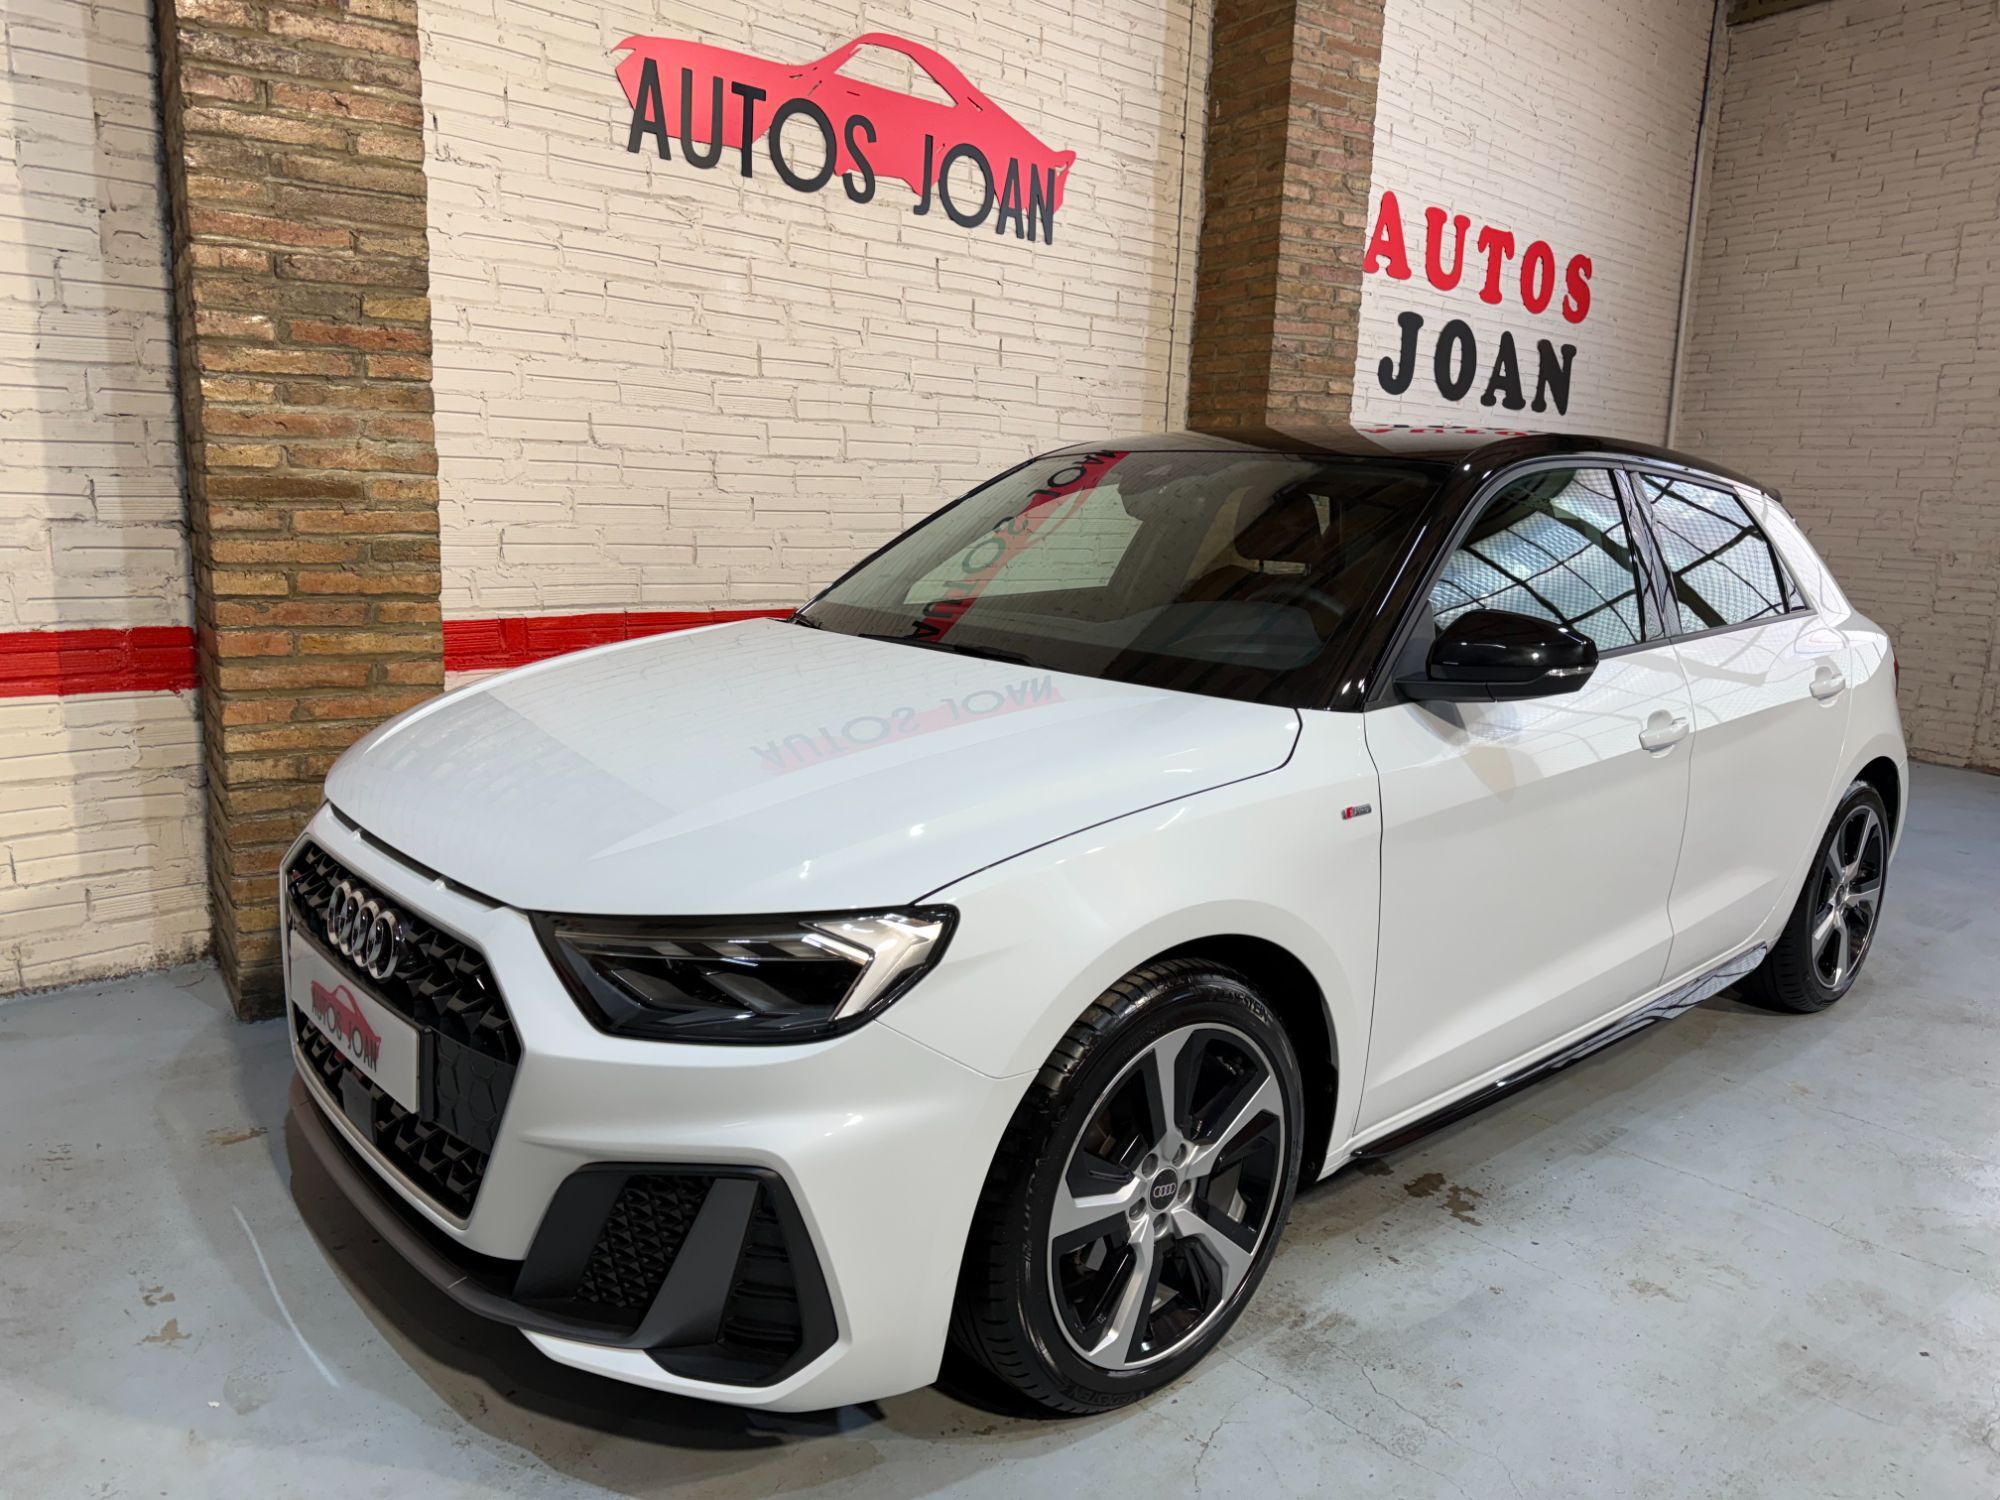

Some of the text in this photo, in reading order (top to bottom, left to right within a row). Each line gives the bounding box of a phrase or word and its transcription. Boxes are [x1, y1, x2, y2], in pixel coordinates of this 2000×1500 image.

[627, 57, 1056, 246] AUTOS JOAN
[1362, 190, 1593, 325] AUTOS
[1377, 311, 1577, 416] JOAN
[311, 988, 377, 1073] AUTOS JOAN
